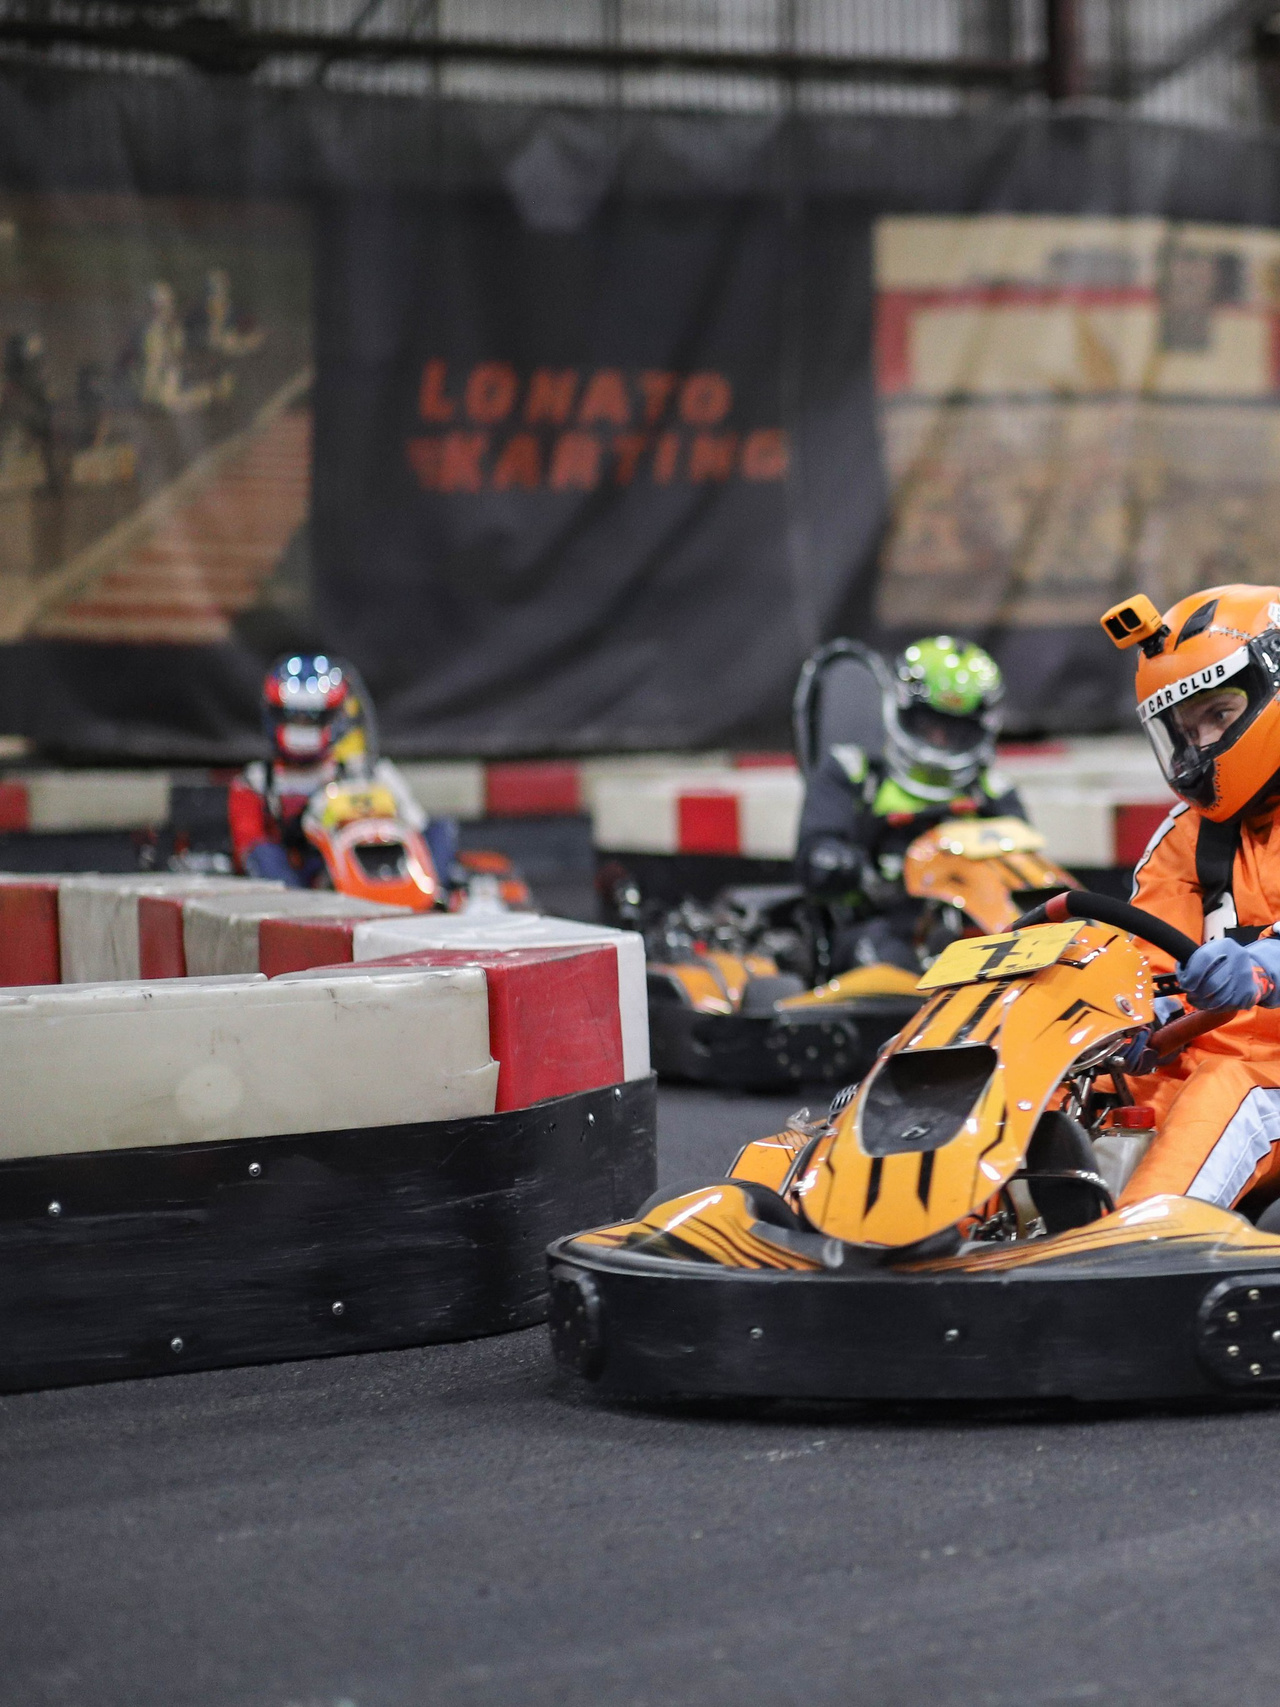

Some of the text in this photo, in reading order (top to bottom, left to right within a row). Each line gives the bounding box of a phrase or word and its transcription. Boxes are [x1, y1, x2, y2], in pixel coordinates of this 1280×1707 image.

[418, 358, 733, 425] LONATO
[407, 428, 790, 494] KARTING
[1148, 689, 1174, 713] CAR
[1179, 664, 1226, 695] CLUB
